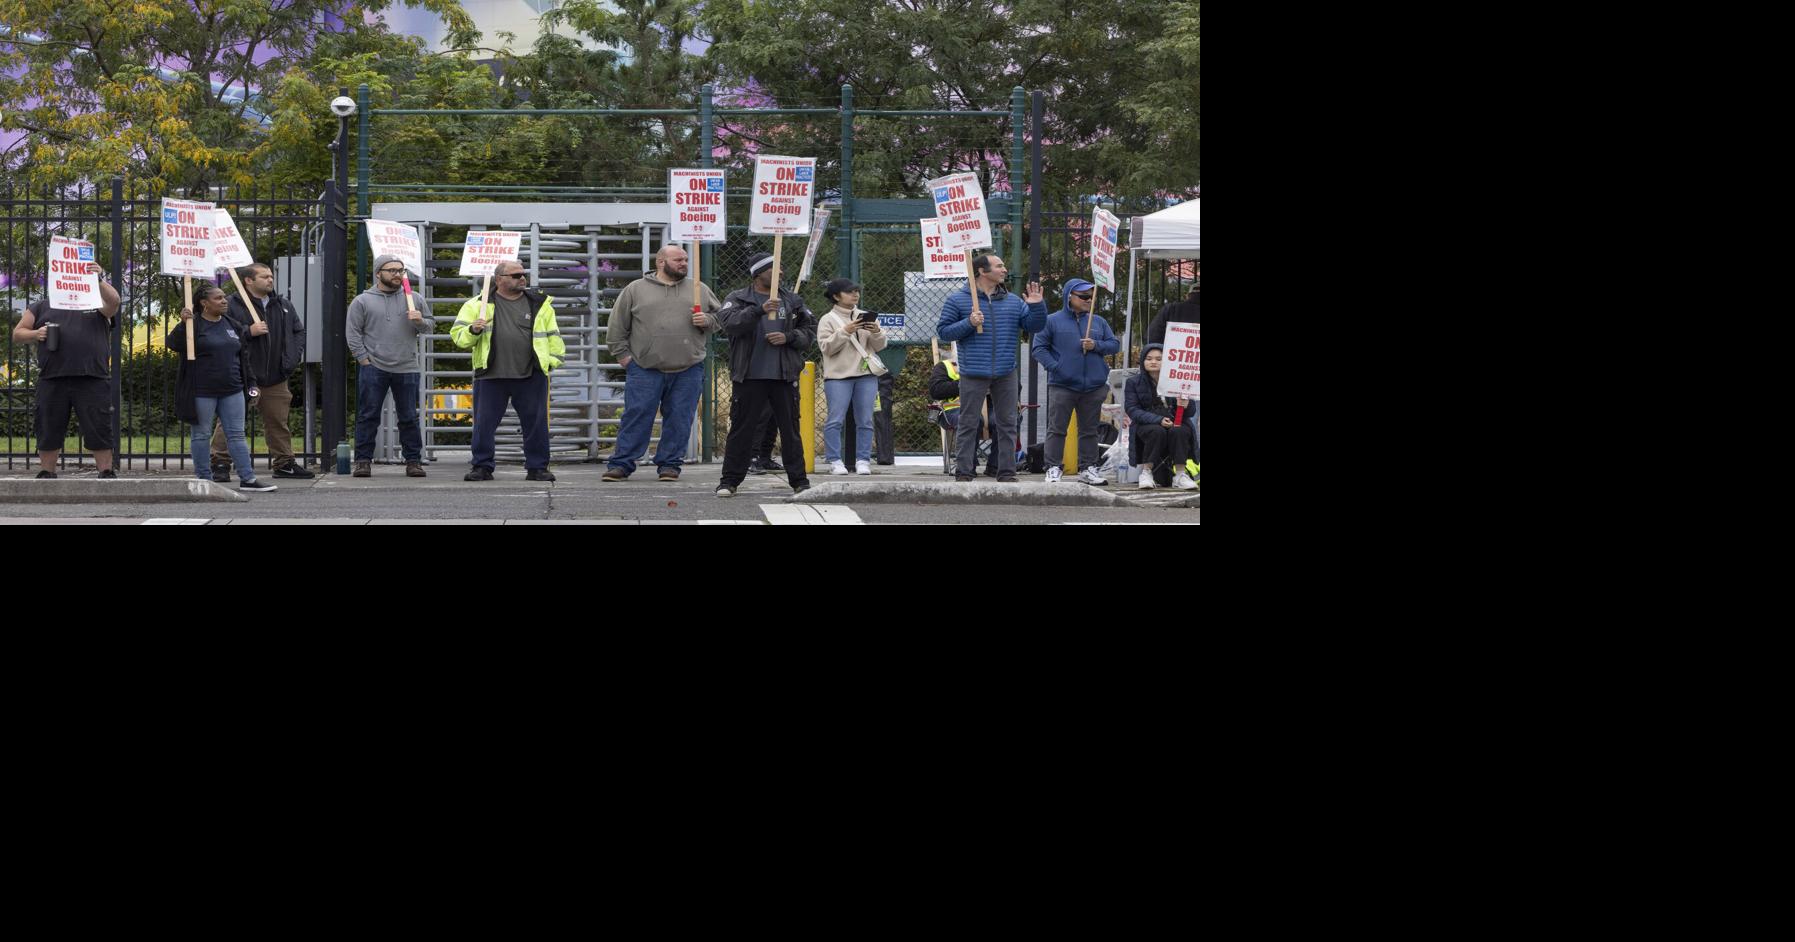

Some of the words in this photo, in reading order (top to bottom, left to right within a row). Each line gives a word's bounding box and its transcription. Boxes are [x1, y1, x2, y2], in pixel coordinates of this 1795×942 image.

[776, 167, 795, 180] ON
[690, 178, 706, 190] ON
[760, 182, 808, 196] STRIKE
[676, 193, 720, 204] STRIKE
[949, 185, 965, 199] ON
[762, 203, 801, 215] Boeing
[939, 198, 980, 216] STRIKE
[178, 211, 195, 224] ON
[680, 212, 716, 223] Boeing
[167, 224, 209, 240] STRIKE
[216, 226, 235, 238] IKE
[947, 219, 981, 233] Boeing
[374, 235, 417, 248] STRIKE
[1094, 235, 1113, 257] STRIKE
[63, 247, 78, 260] ON
[171, 245, 205, 258] Boeing
[216, 244, 239, 254] eing
[469, 246, 514, 254] STRIKE
[471, 257, 506, 265] Boein
[931, 254, 964, 262] Boeing
[1093, 254, 1110, 273] Boeing
[56, 280, 90, 293] Boeing
[1168, 349, 1200, 363] STRI
[1169, 369, 1200, 381] Boein
